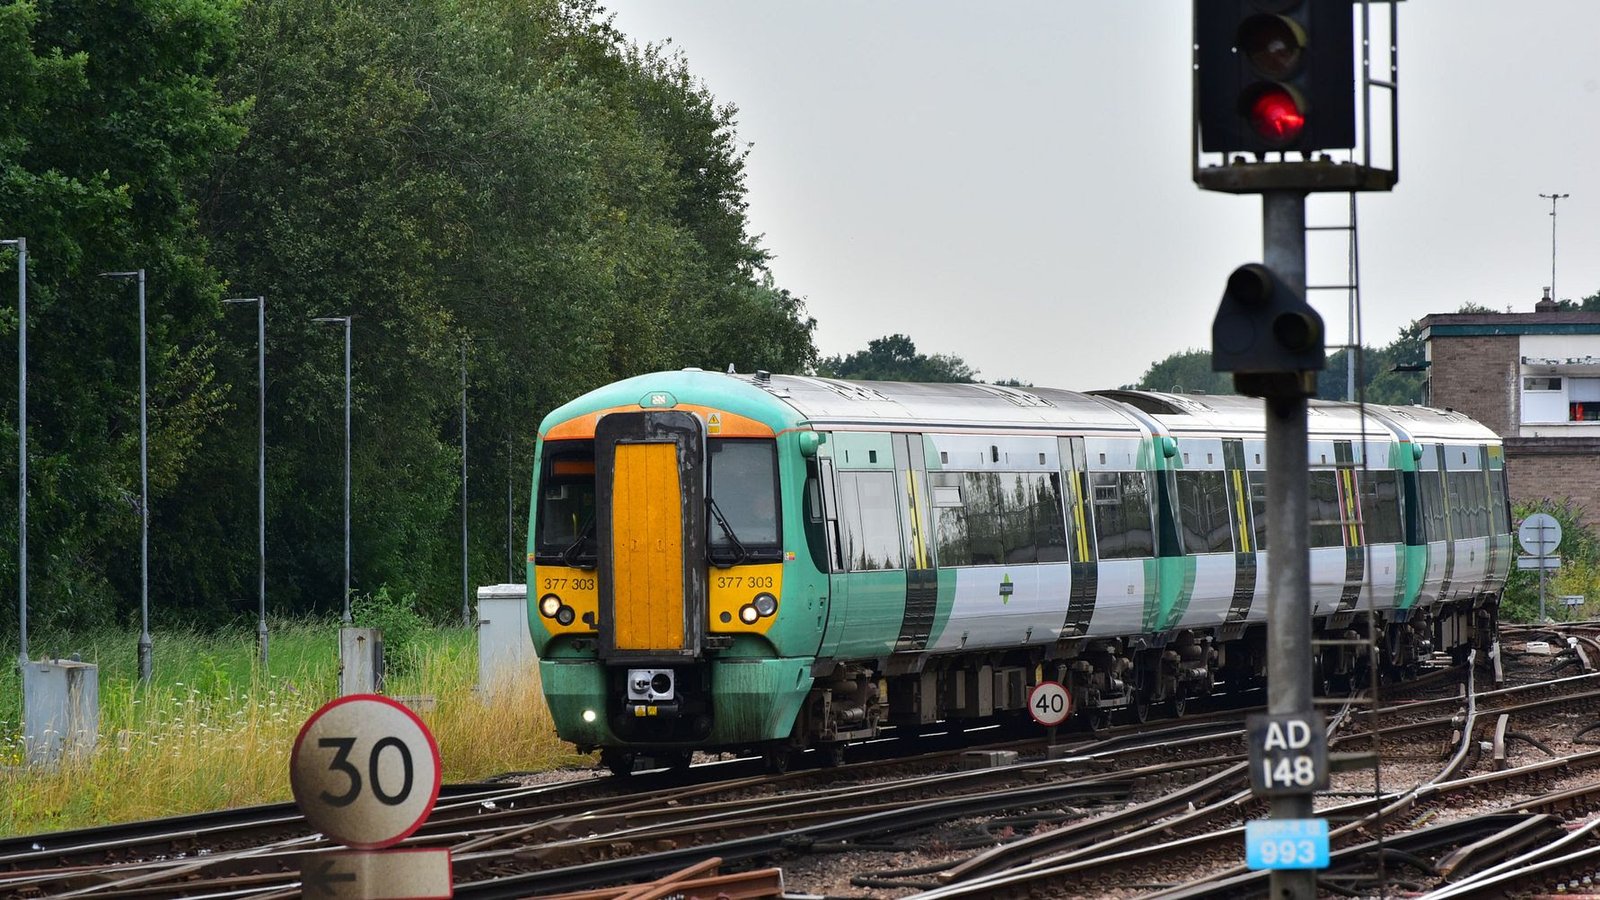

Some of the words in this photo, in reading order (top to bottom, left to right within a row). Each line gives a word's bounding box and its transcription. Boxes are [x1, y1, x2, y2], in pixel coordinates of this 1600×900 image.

[544, 578, 568, 590] 377
[572, 578, 595, 591] 303
[717, 576, 742, 589] 377
[748, 576, 773, 588] 303
[1035, 693, 1063, 713] 40
[1263, 719, 1312, 752] AD
[318, 736, 414, 807] 30
[1263, 755, 1315, 789] 148
[1260, 839, 1316, 864] 993
